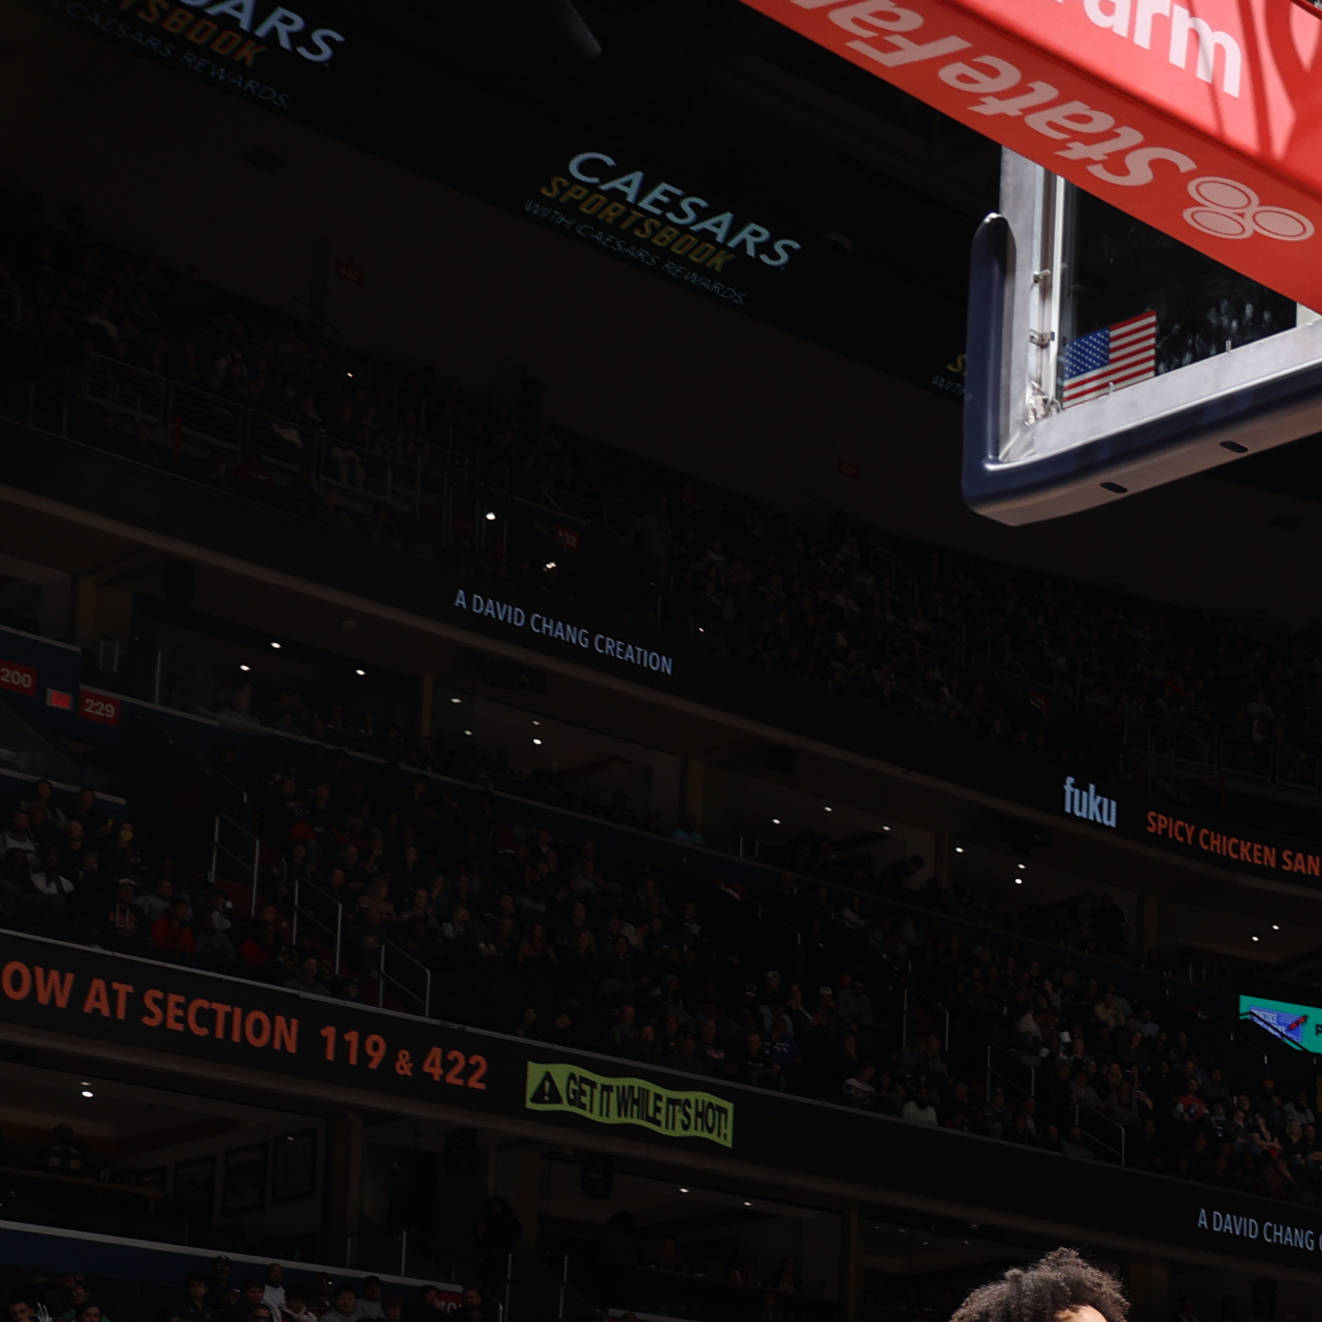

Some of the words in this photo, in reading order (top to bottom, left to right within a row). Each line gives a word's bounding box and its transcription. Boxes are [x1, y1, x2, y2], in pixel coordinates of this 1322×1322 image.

[790, 0, 973, 68] Fa
[1055, 0, 1241, 98] arm
[938, 54, 1197, 187] State
[539, 175, 737, 272] SPORTSBOOK
[567, 151, 803, 268] CAESARS
[1, 666, 32, 689] 200
[454, 588, 468, 609] A
[472, 594, 526, 628] DAVID
[530, 612, 590, 649] CHANG
[594, 634, 673, 676] CREATION
[84, 697, 116, 719] 229
[1063, 775, 1118, 828] fuku
[1145, 809, 1196, 846] SPICY
[1199, 828, 1278, 869] CHICKEN
[1, 960, 76, 1010] OW
[83, 977, 134, 1021] AT
[141, 987, 300, 1055] SECTION
[320, 1024, 388, 1071] 119
[394, 1048, 413, 1078] &
[422, 1046, 489, 1091] 422
[566, 1071, 597, 1116] GET
[600, 1080, 614, 1118] IT
[616, 1084, 662, 1127] WHILE
[664, 1097, 692, 1131] IT'S
[693, 1102, 729, 1140] HOT!
[1197, 1207, 1208, 1230] A
[1212, 1210, 1260, 1240] DAVID
[1262, 1221, 1315, 1251] CHANG
